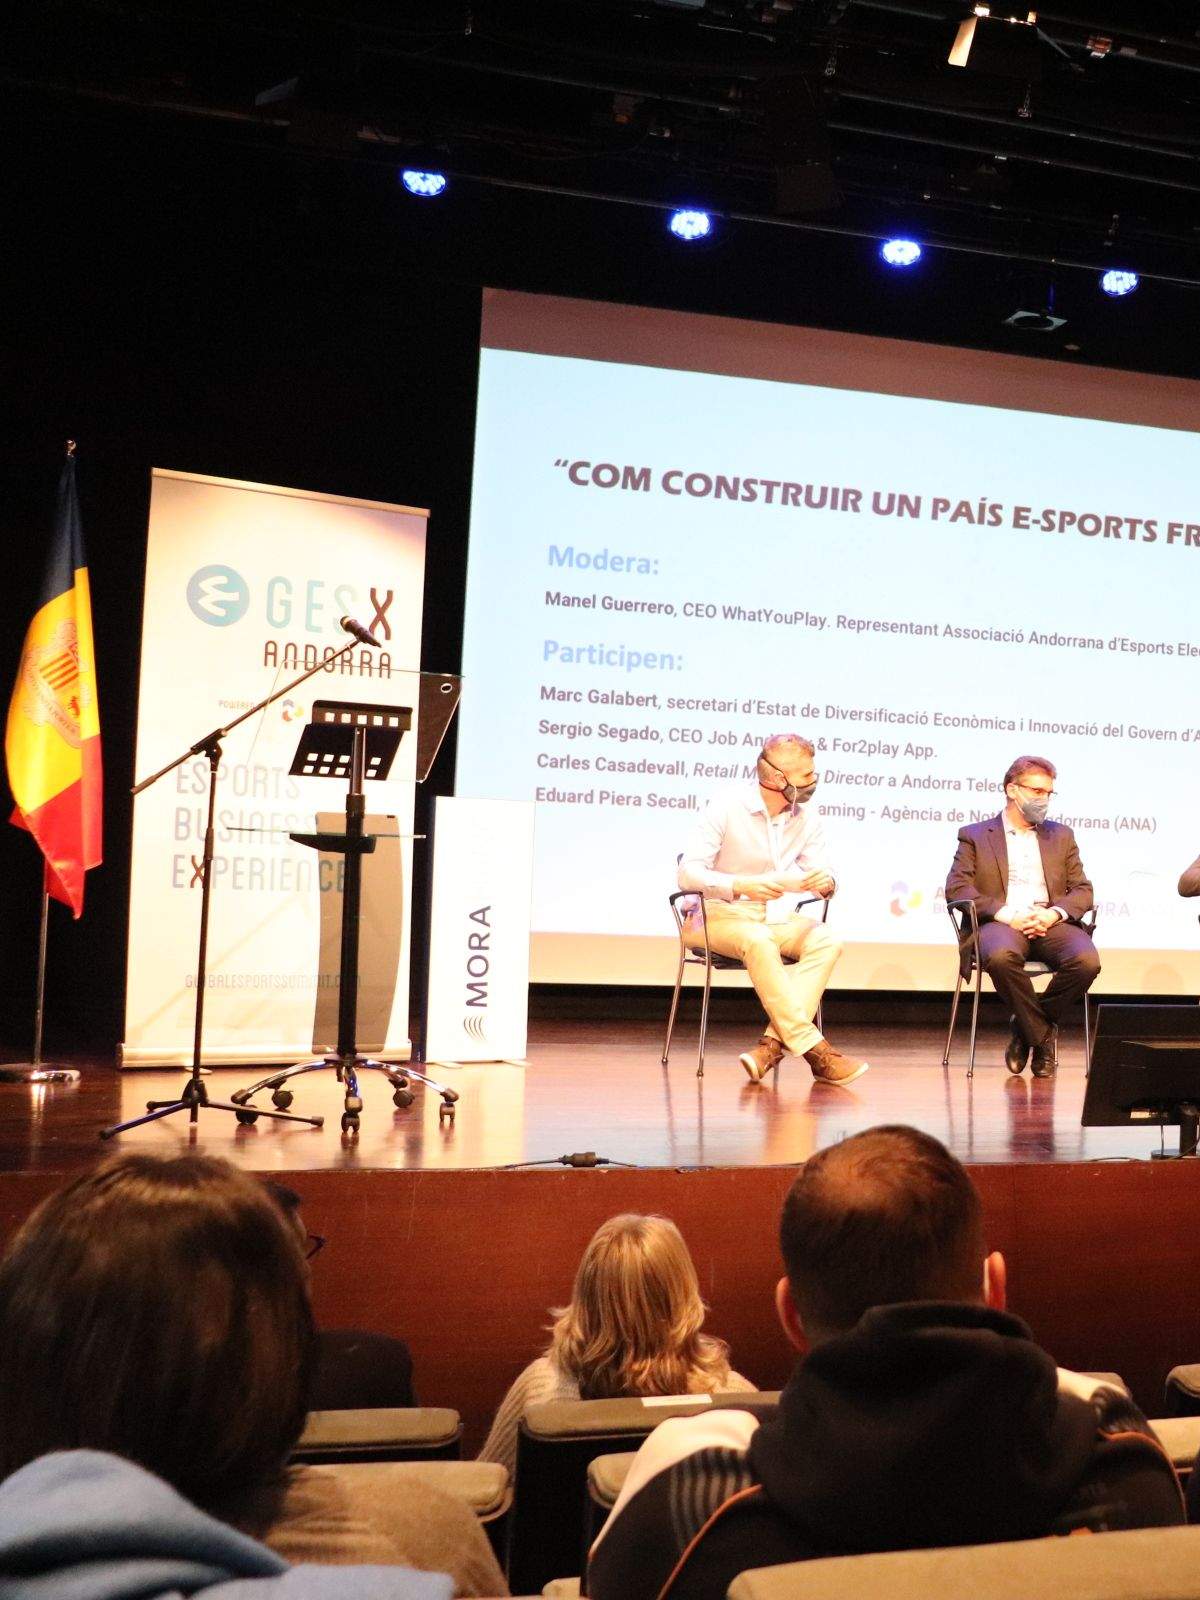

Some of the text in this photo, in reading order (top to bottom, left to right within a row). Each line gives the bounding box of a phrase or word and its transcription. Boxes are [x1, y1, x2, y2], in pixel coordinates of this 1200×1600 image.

[661, 470, 862, 513] CONSTRUIR
[872, 492, 921, 518] UN
[931, 497, 1003, 527] PAÍS
[1012, 506, 1157, 542] E-SPORTS
[548, 545, 658, 575] Modera:
[546, 591, 596, 608] Manel
[602, 596, 677, 617] Guerrero,
[683, 602, 716, 618] CEO
[722, 605, 830, 630] WhatYouPlay.
[837, 615, 938, 636] Representant
[943, 624, 1024, 643] Associació
[1029, 631, 1103, 649] Andorrana
[264, 640, 391, 679] ANDORRA
[543, 640, 682, 672] Participen:
[541, 686, 582, 702] Marc
[588, 689, 661, 709] Galabert,
[667, 698, 737, 712] secretari
[801, 703, 820, 718] de
[826, 705, 928, 725] Diversificació
[934, 713, 1015, 731] Econòmica
[1020, 718, 1023, 731] i
[1029, 719, 1098, 736] Innovació
[1103, 723, 1123, 737] del
[1128, 725, 1177, 741] Govern
[539, 720, 592, 739] Sergio
[598, 723, 663, 744] Segado,
[669, 728, 702, 743] CEO
[708, 731, 737, 745] Job
[817, 737, 828, 751] &
[833, 738, 899, 758] For2play
[904, 743, 937, 760] App.
[176, 761, 300, 799] ESPORTS
[537, 753, 590, 770] Carles
[595, 757, 688, 778] Casadevall,
[693, 763, 738, 778] Retail
[824, 770, 884, 786] Director
[888, 777, 896, 787] a
[901, 774, 961, 790] Andorra
[966, 777, 1004, 793] Telec
[536, 787, 594, 804] Eduard
[599, 790, 641, 806] Piera
[647, 793, 699, 811] Secall,
[818, 803, 865, 821] aming
[881, 806, 942, 823] Agència
[947, 808, 964, 822] de
[1046, 812, 1110, 830] dorrana
[1114, 816, 1156, 834] (ANA)
[465, 905, 492, 1008] MORA
